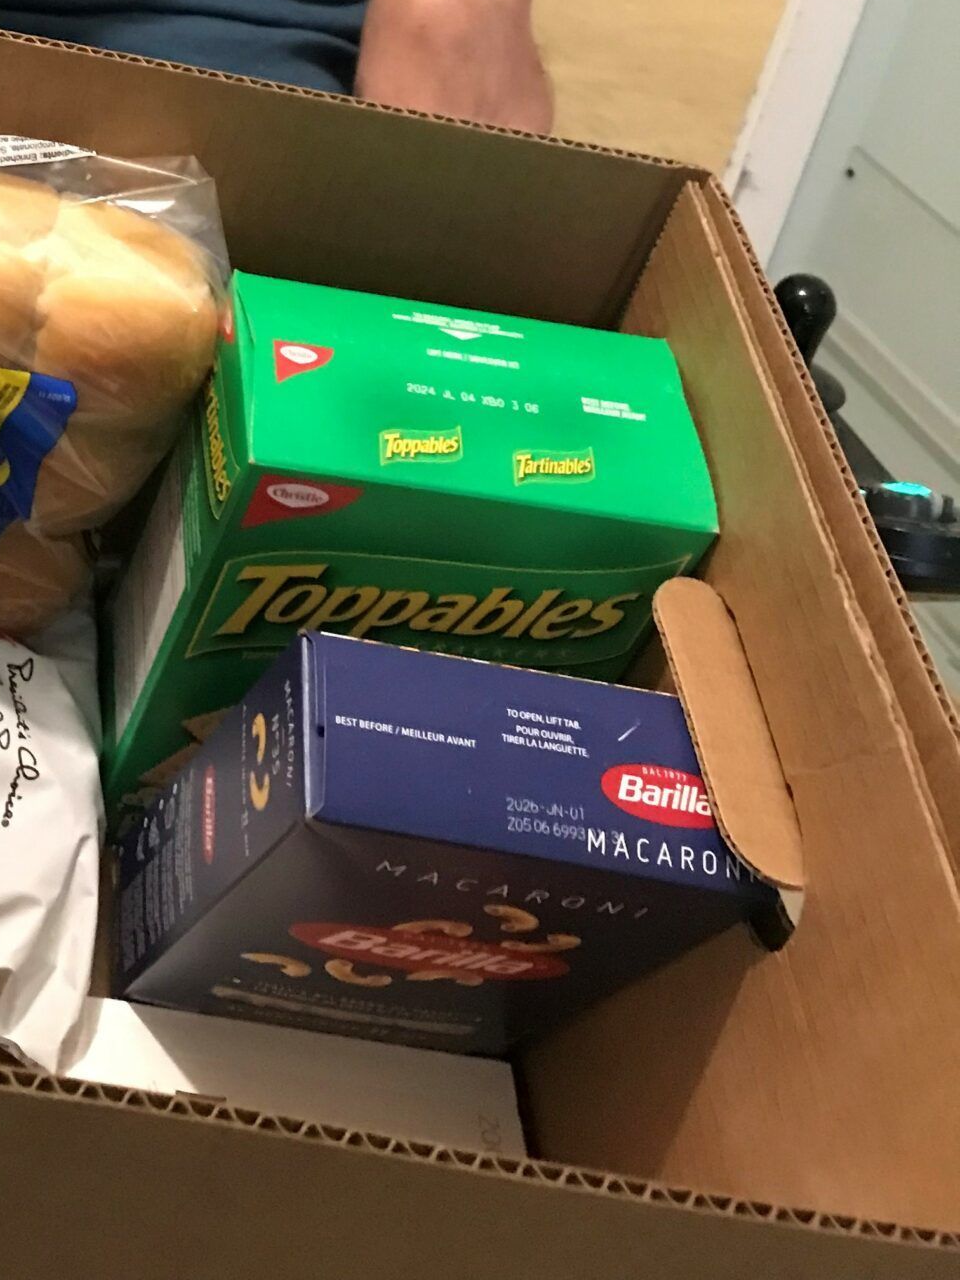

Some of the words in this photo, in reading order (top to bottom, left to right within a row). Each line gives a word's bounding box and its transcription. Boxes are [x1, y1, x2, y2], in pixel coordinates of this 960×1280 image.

[407, 382, 436, 396] 2024
[384, 432, 459, 458] Toppables
[516, 454, 591, 479] Tartinables
[272, 487, 324, 504] Christie
[211, 563, 642, 640] Toppables
[506, 708, 518, 719] TO
[519, 710, 545, 724] OPEN,
[545, 714, 563, 726] LIFT
[335, 715, 358, 728] BEST
[359, 719, 394, 734] BEFORE
[401, 727, 445, 743] MEILLEUR
[447, 734, 477, 748] AVANT
[502, 733, 526, 747] TIRER
[526, 738, 538, 749] LA
[515, 724, 539, 737] POUR
[2, 746, 40, 820] Choice
[618, 773, 712, 817] Barilla
[533, 820, 550, 836] 06
[376, 859, 649, 919] MACARONI
[317, 930, 534, 975] Barilla
